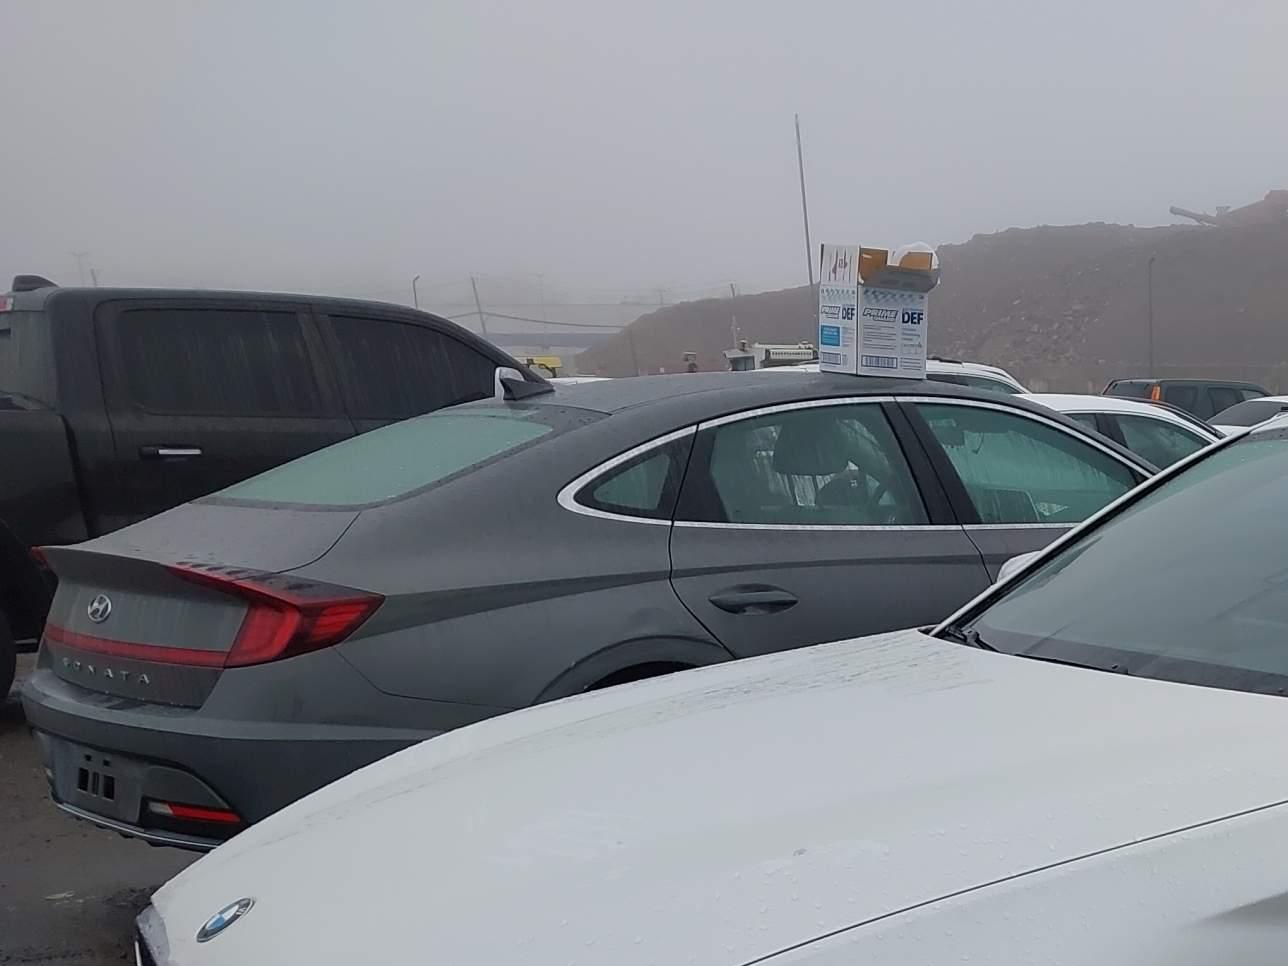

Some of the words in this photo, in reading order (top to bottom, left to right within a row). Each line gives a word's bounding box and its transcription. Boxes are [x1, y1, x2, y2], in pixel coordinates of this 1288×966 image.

[842, 307, 856, 321] DEF
[902, 311, 924, 325] DEF
[62, 656, 150, 685] SONATA
